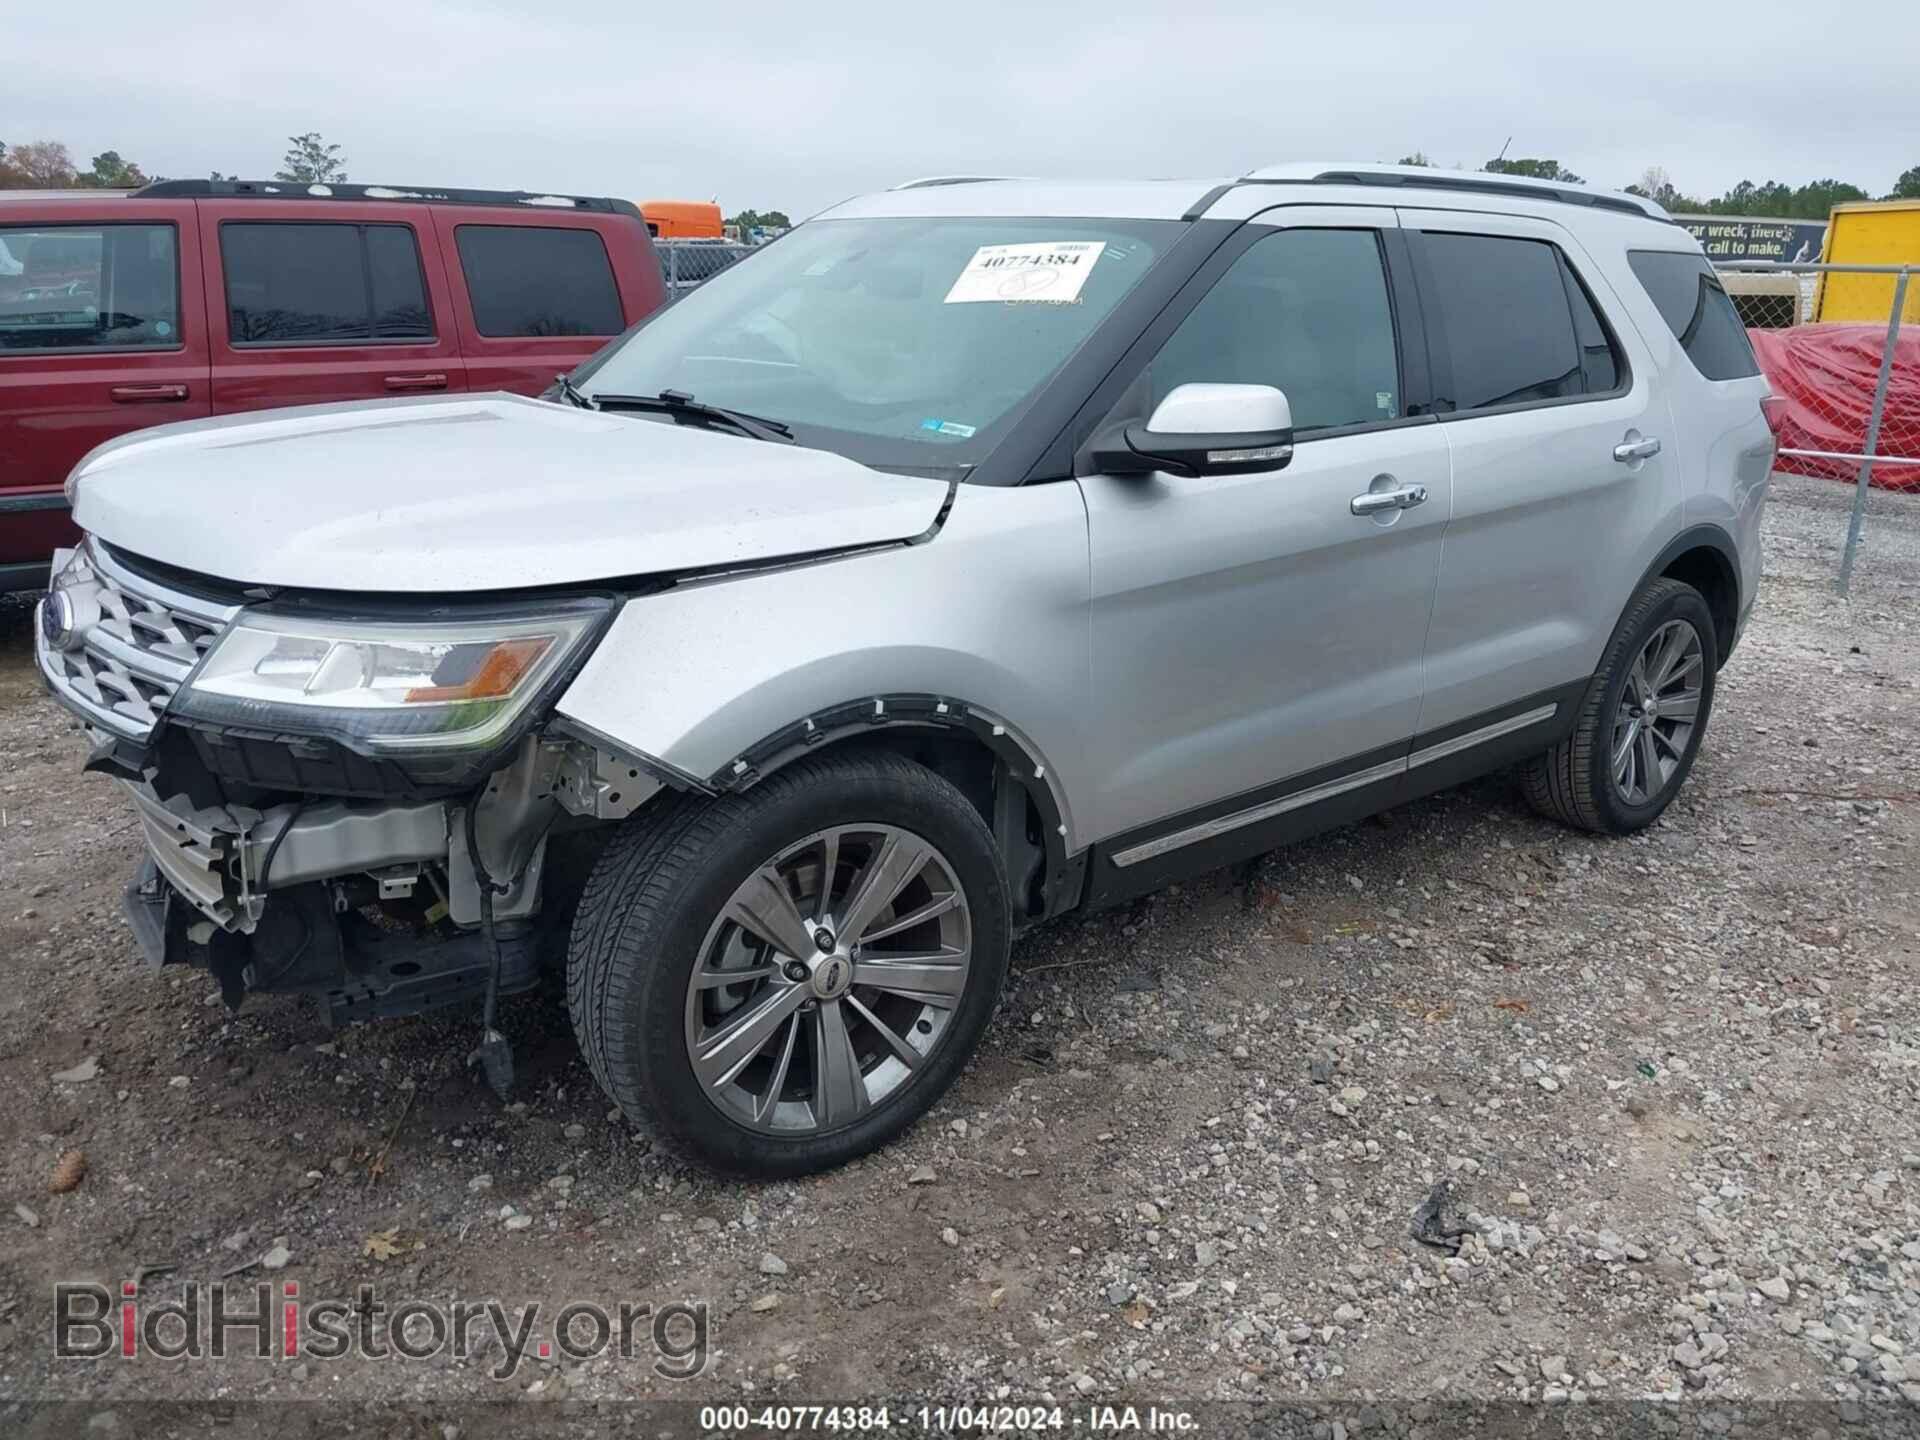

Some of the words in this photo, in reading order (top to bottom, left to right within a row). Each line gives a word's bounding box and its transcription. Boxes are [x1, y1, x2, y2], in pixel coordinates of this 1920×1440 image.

[1708, 224, 1748, 239] wreck,
[1707, 240, 1729, 254] call
[1732, 242, 1745, 254] to
[1748, 241, 1783, 255] make.
[979, 254, 1081, 269] 40774384
